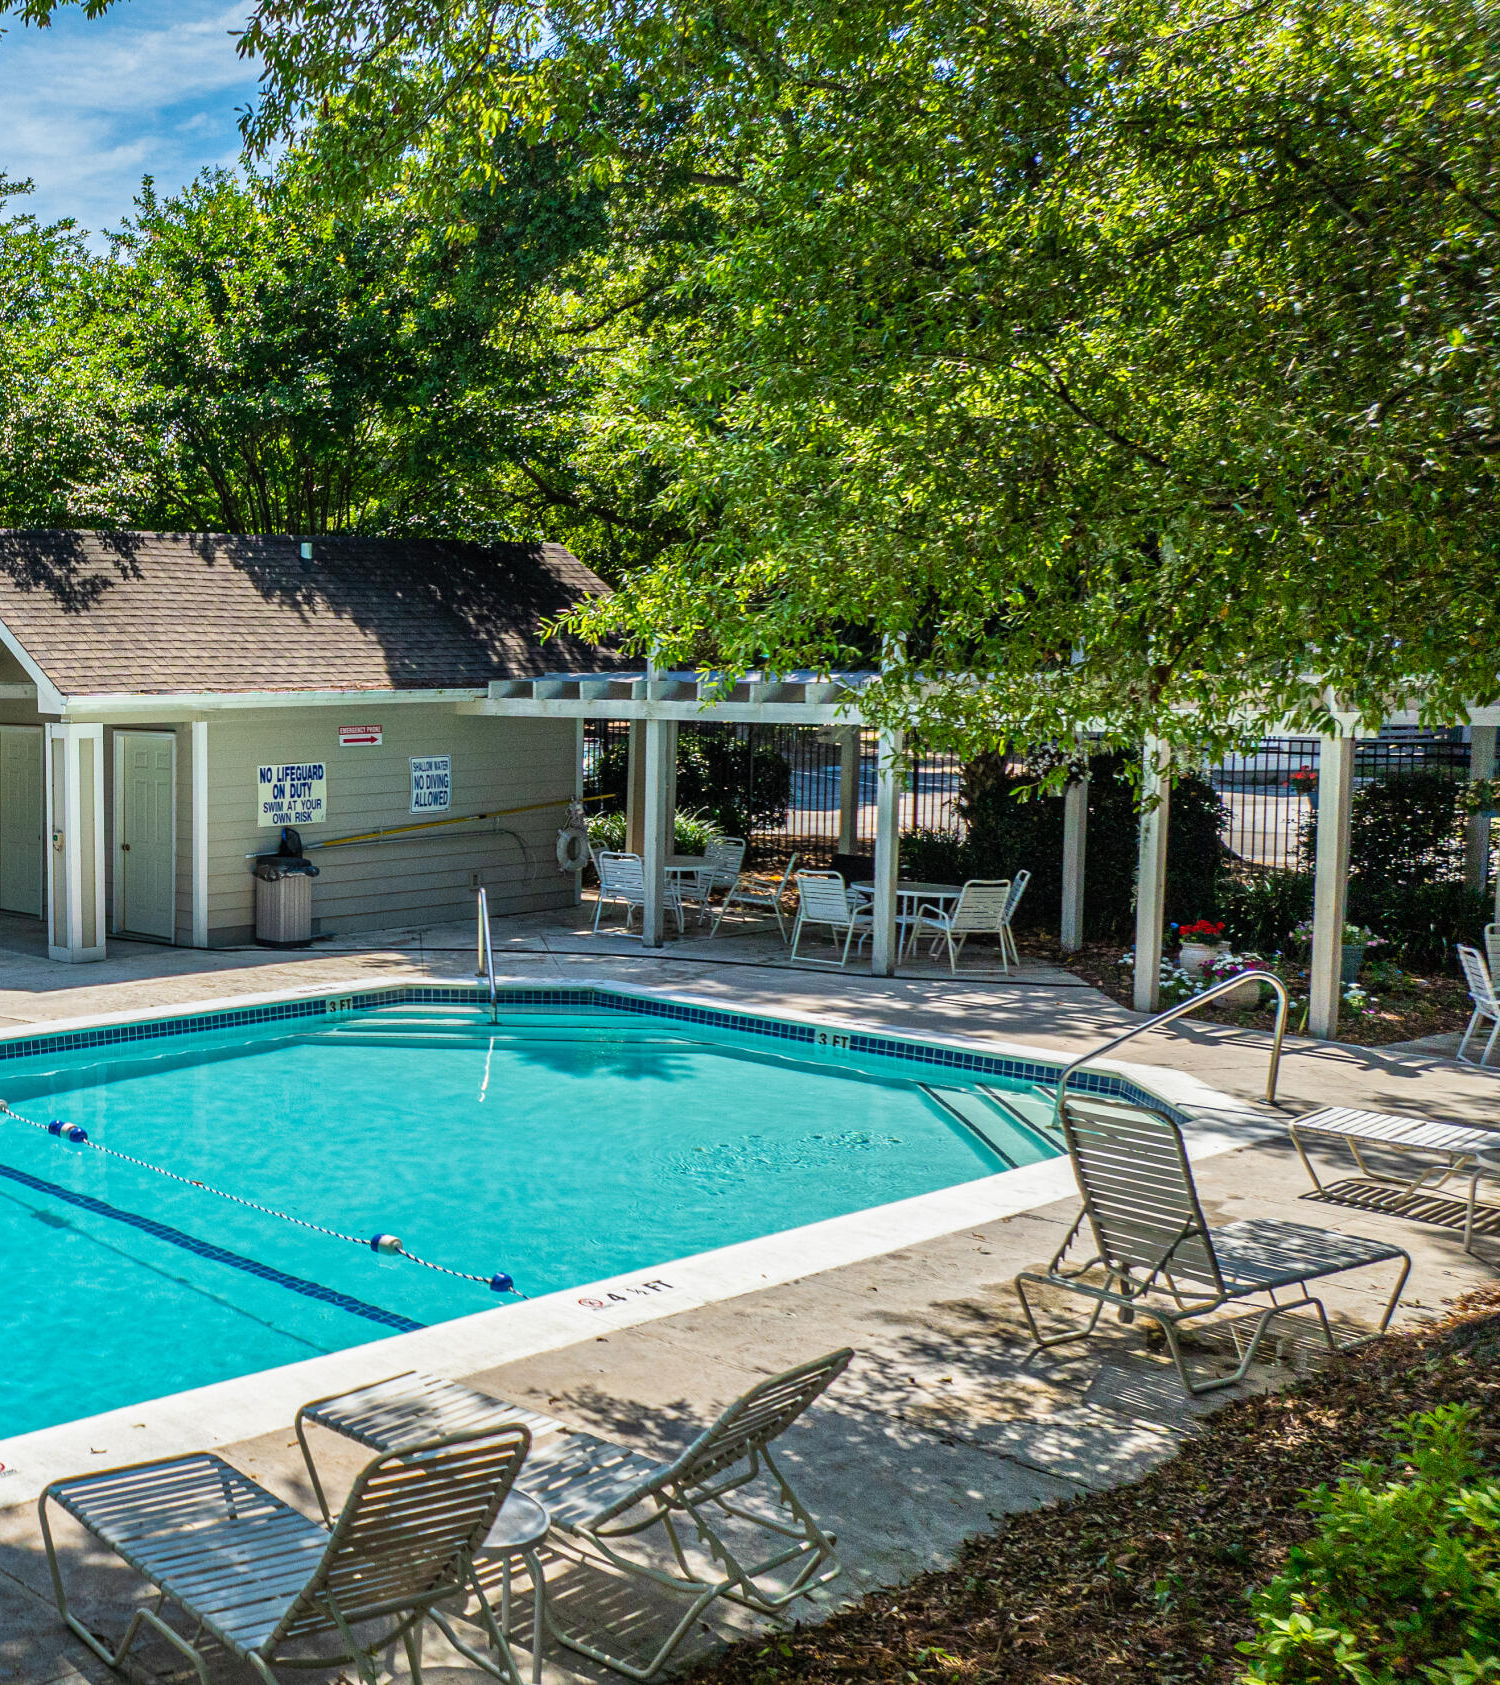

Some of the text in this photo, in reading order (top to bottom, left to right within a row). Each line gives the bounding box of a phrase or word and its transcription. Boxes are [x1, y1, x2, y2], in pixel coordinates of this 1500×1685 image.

[260, 764, 324, 784] NO LIFEGUARD
[413, 761, 433, 772] SHALLOW
[414, 773, 448, 790] NO DIVING
[272, 782, 312, 800] ON DUTY
[414, 790, 448, 807] ALLOWED
[263, 799, 322, 813] SWIM AT YOUR
[272, 811, 312, 824] OWN RISK
[329, 998, 352, 1013] 3 FT
[818, 1033, 849, 1049] 3 FT
[606, 1293, 627, 1301] 4
[642, 1280, 674, 1292] FT
